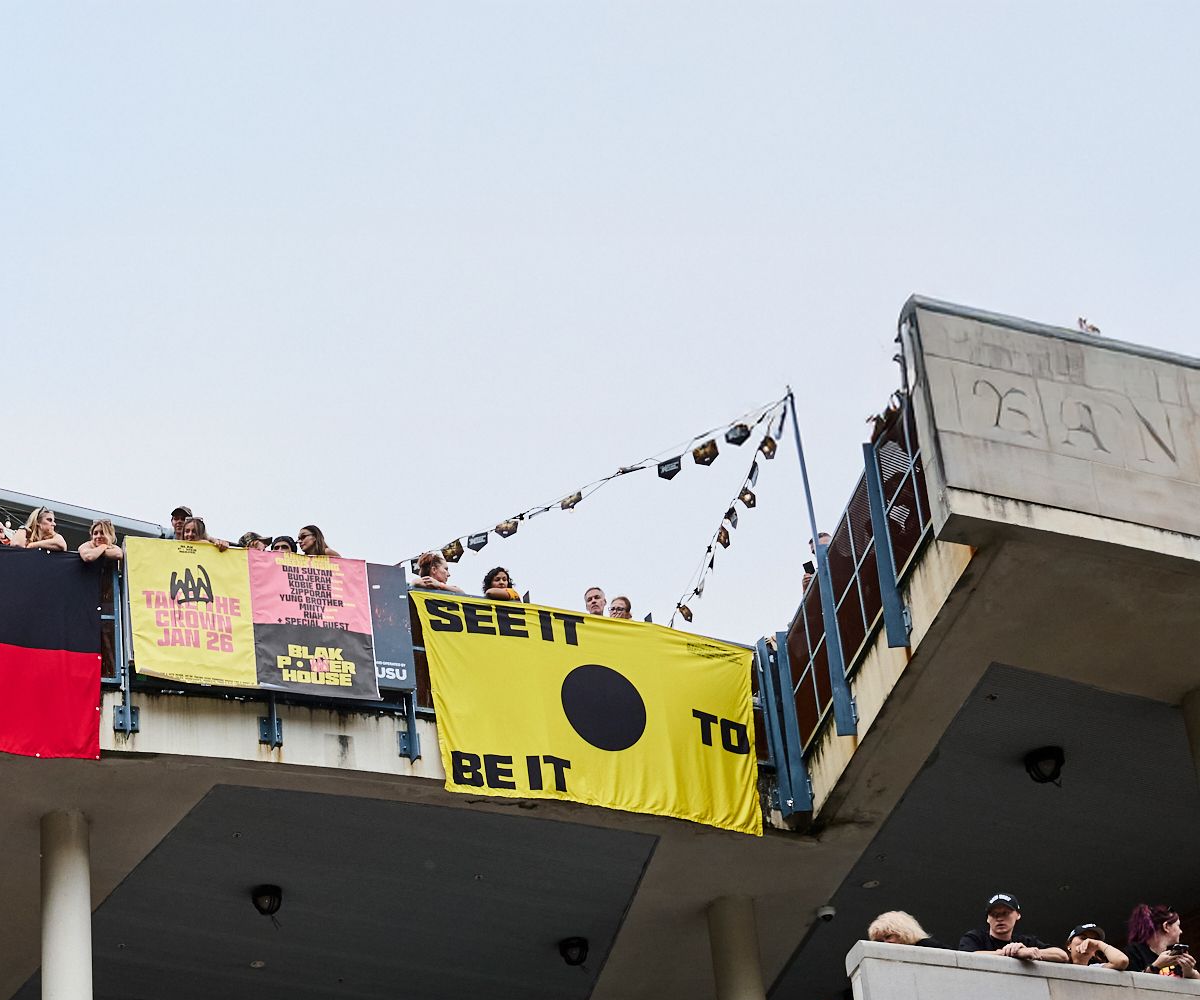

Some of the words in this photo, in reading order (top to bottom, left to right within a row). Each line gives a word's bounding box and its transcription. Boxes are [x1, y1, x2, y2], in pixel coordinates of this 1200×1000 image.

[282, 565, 300, 575] DAN
[301, 567, 333, 577] SULTAN
[288, 573, 332, 584] BUDJERAH
[288, 580, 314, 590] KOBIE
[315, 582, 332, 591] DEE
[290, 587, 332, 598] ZIPPORAH
[279, 594, 304, 603] YUNG
[305, 596, 344, 607] BROTHER
[299, 603, 326, 612] MINTY
[155, 609, 233, 634] CROWN
[303, 611, 323, 620] RIAH
[285, 617, 320, 628] SPECIAL
[424, 599, 529, 638] SEE
[539, 610, 585, 646] IT
[157, 628, 200, 648] JAN
[206, 631, 234, 653] 26
[288, 644, 343, 661] BLAK
[282, 669, 353, 687] HOUSE
[691, 709, 750, 755] TO
[450, 750, 516, 790] BE
[526, 755, 571, 792] IT
